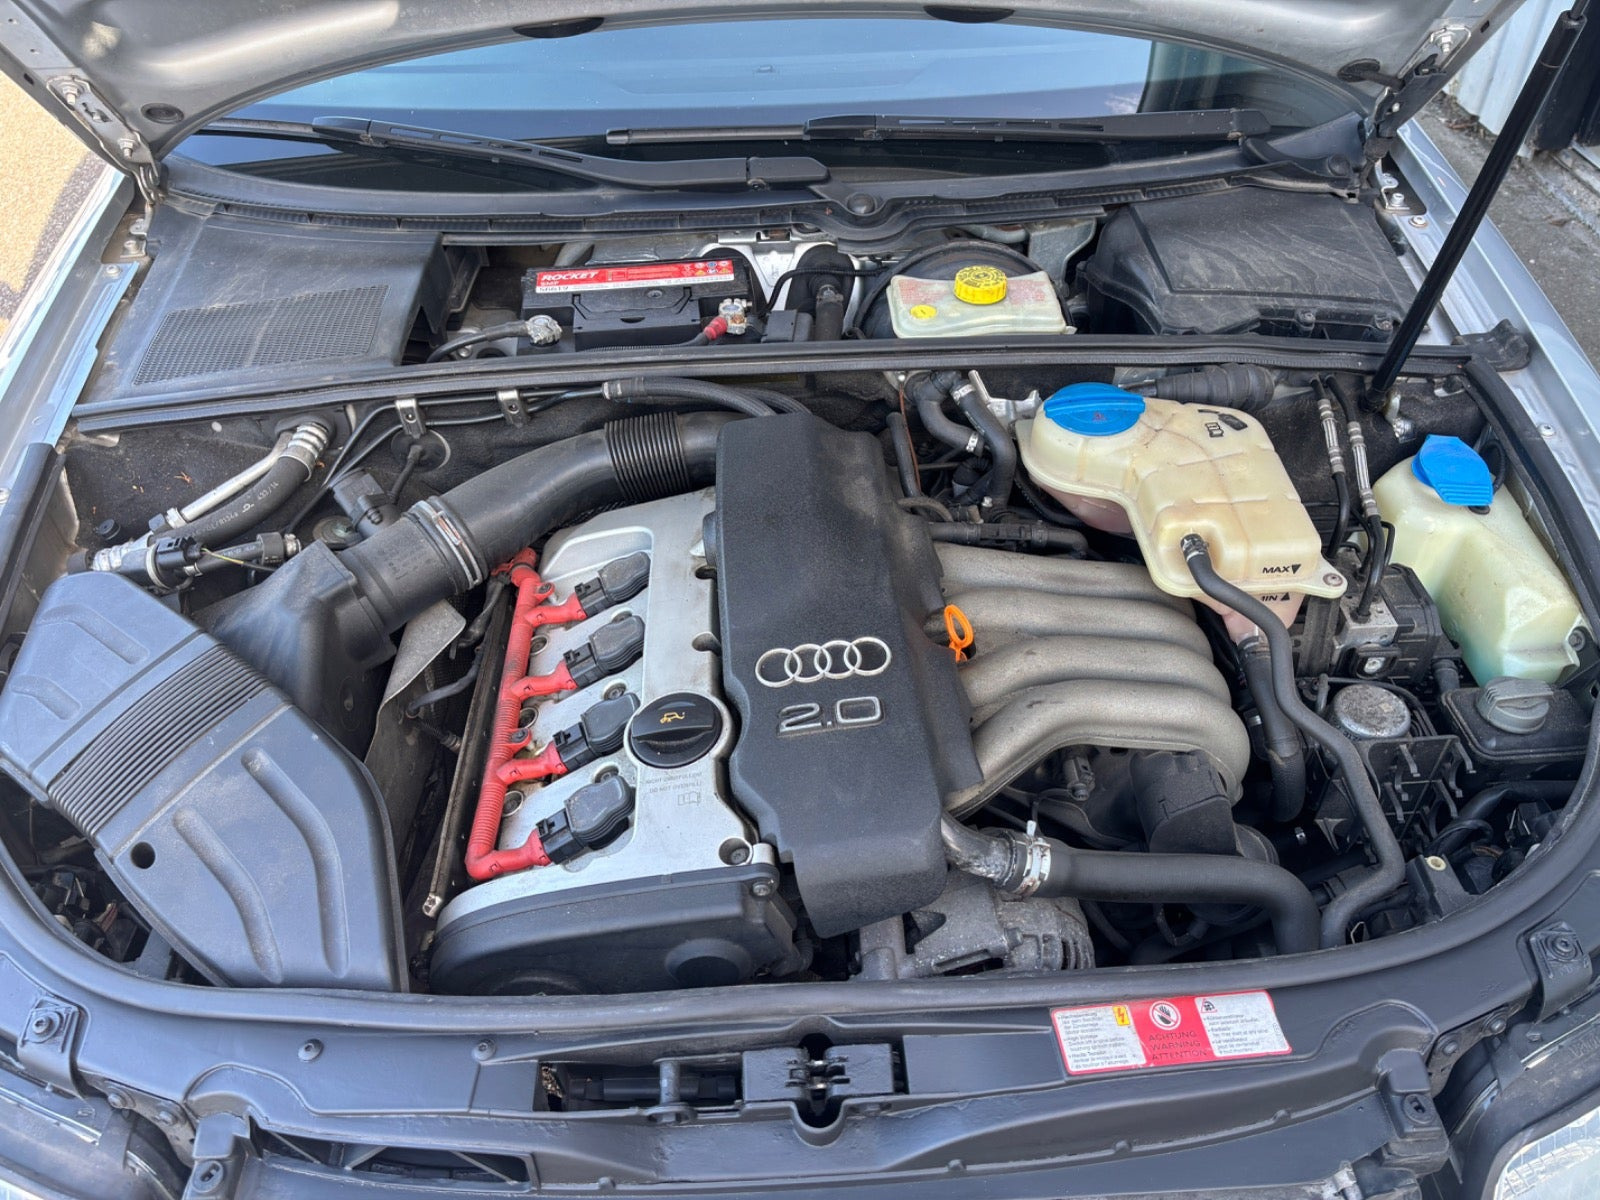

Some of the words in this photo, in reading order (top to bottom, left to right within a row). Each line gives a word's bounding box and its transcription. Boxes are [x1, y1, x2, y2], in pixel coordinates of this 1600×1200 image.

[541, 271, 599, 281] ROCKET
[1262, 565, 1291, 574] MAX
[778, 695, 883, 734] 2.0
[1149, 1031, 1197, 1041] ACHTUNG
[1151, 1040, 1201, 1051] WARNING
[1152, 1050, 1207, 1060] ATTENTION
